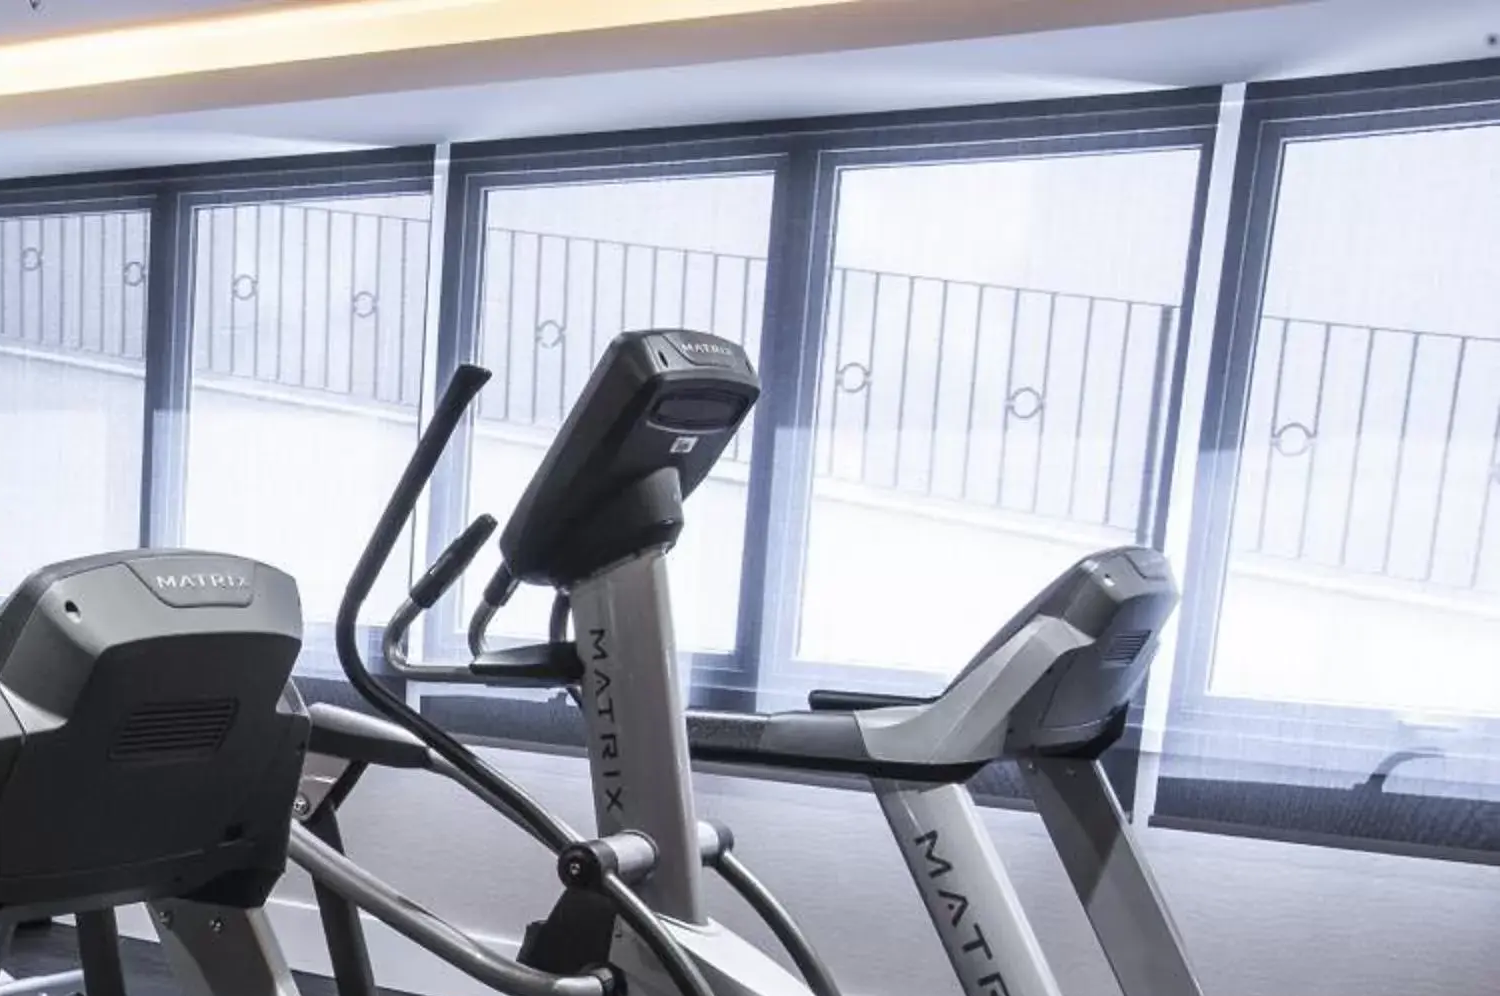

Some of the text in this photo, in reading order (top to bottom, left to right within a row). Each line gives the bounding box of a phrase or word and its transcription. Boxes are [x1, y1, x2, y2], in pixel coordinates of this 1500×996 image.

[680, 343, 732, 356] MATRIX
[156, 574, 250, 588] MATRIX
[589, 629, 624, 812] MATRIX
